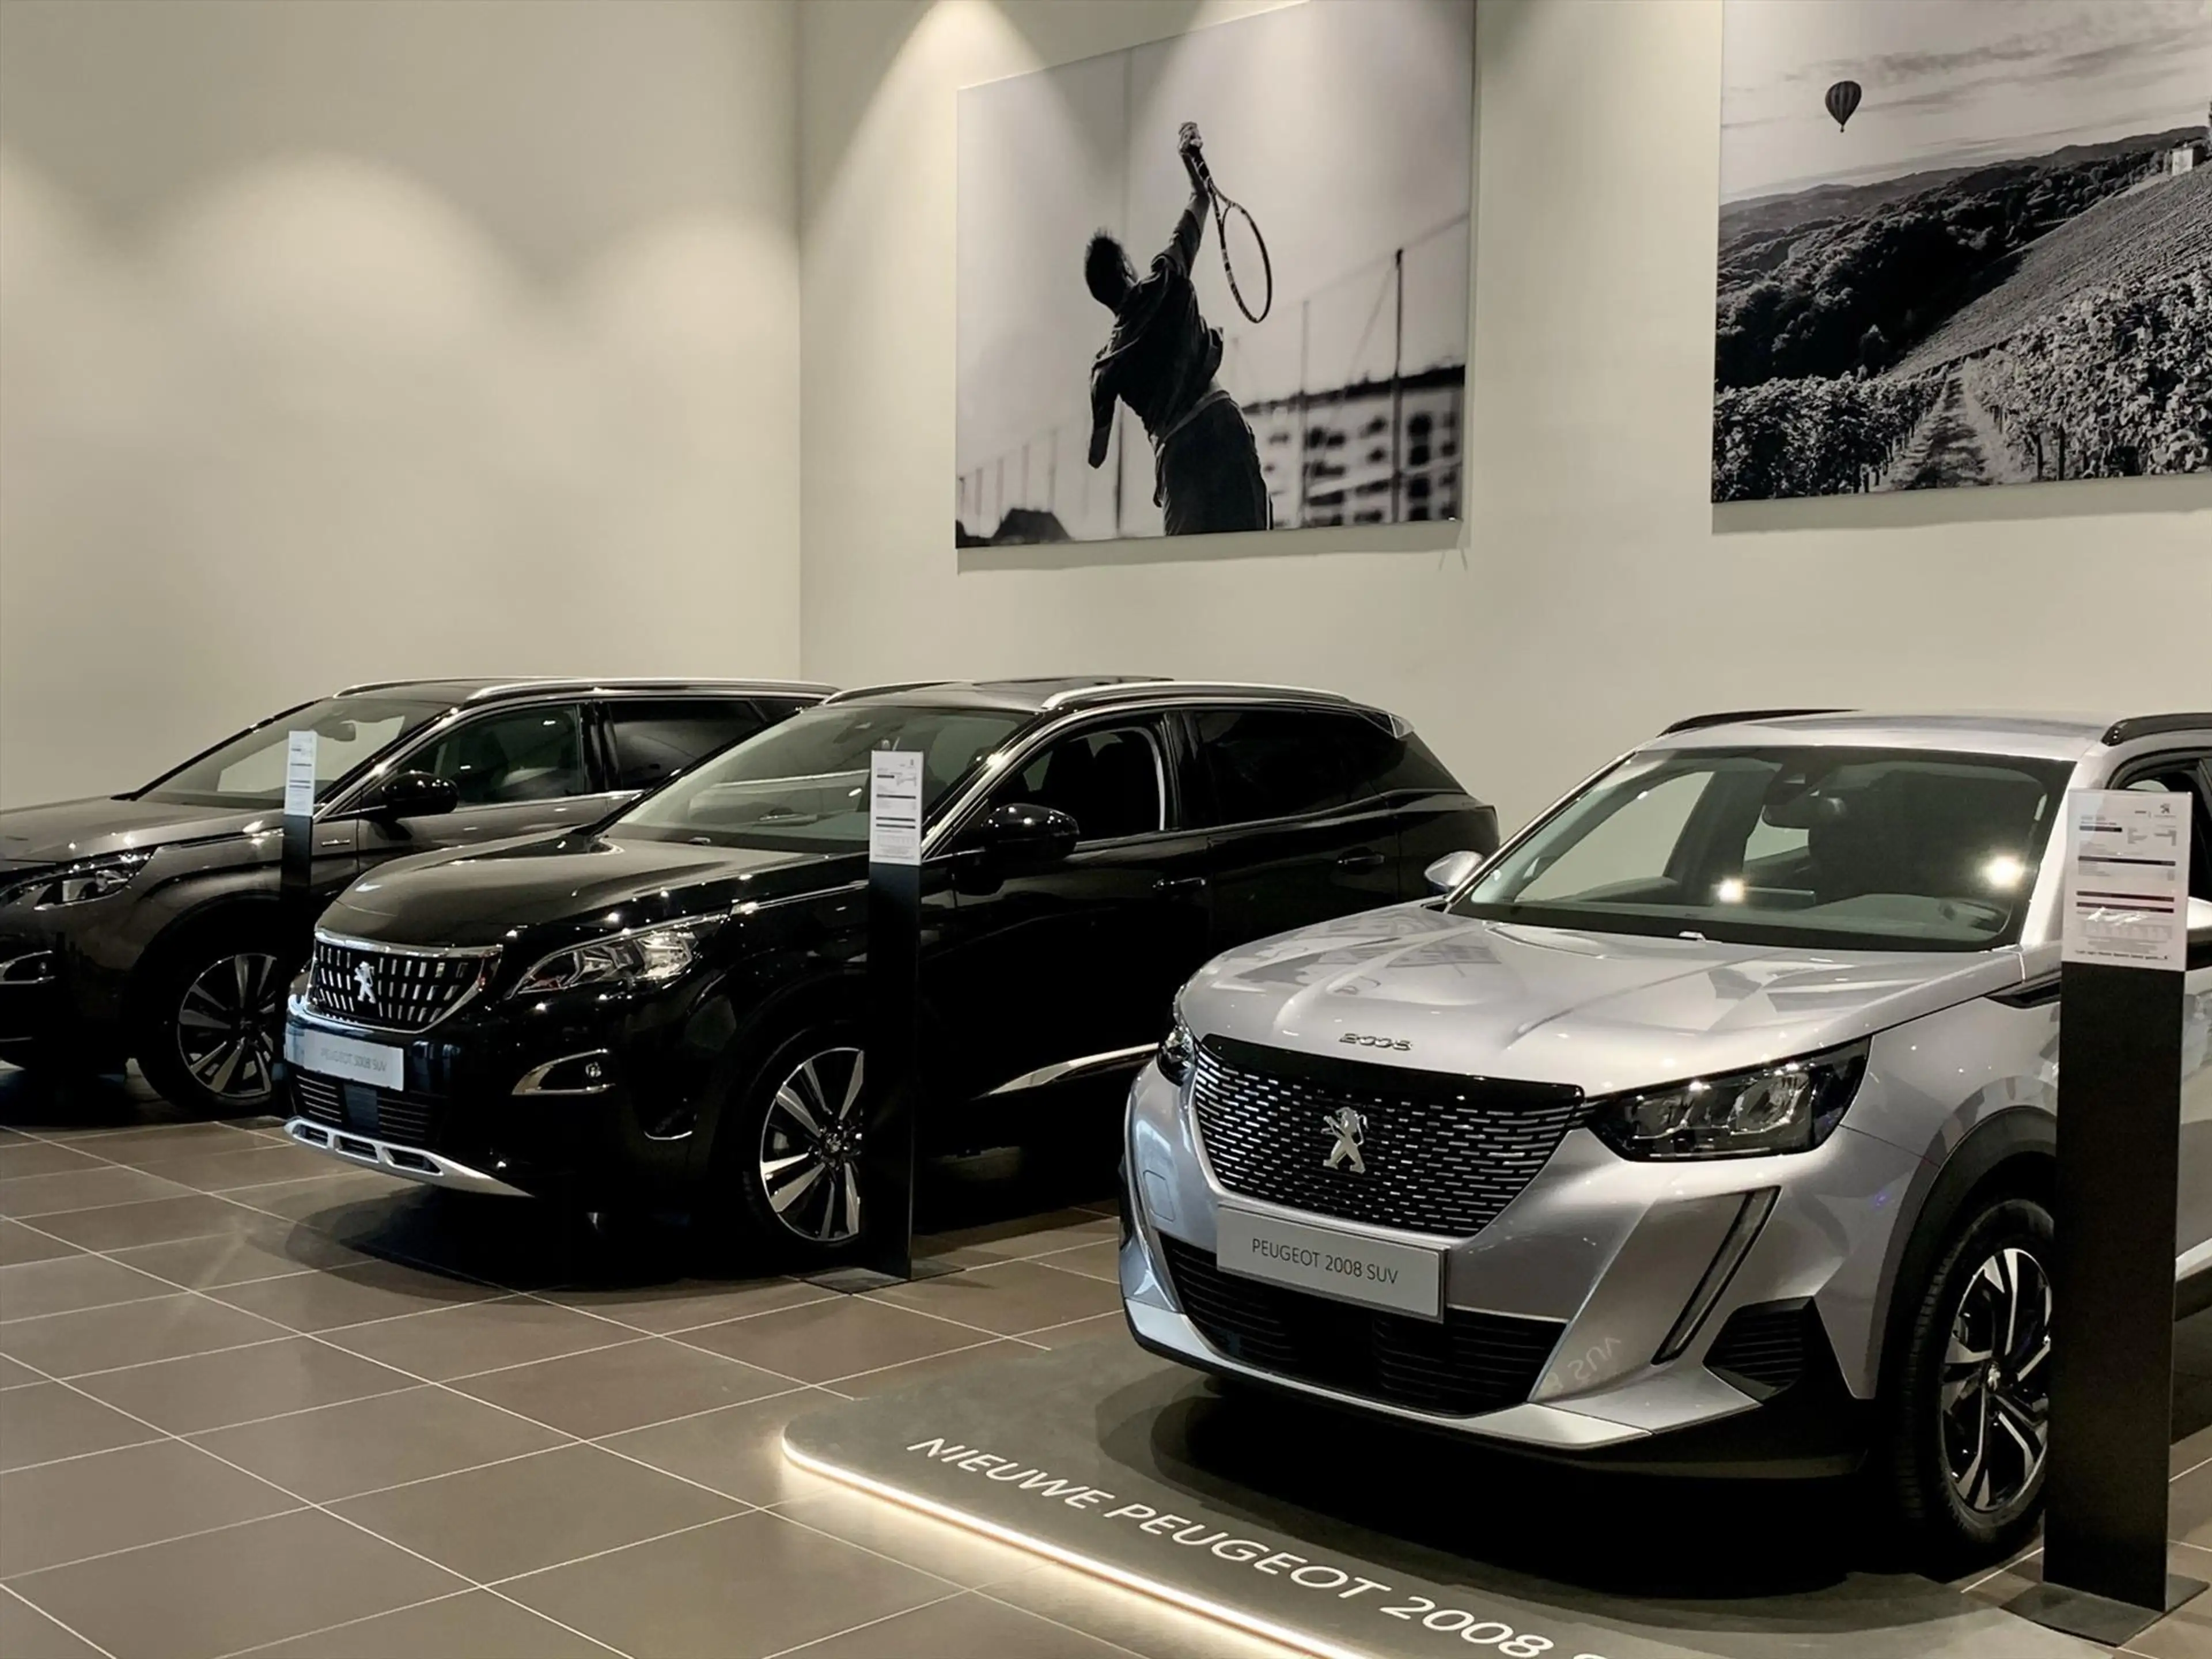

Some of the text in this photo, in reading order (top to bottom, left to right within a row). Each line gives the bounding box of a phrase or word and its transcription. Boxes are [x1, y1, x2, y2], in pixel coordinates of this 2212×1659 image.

[1252, 1238, 1399, 1284] PEUGEOT 2008 SUV
[907, 1438, 1555, 1658] NIEUWE PEUGEOT 2008
